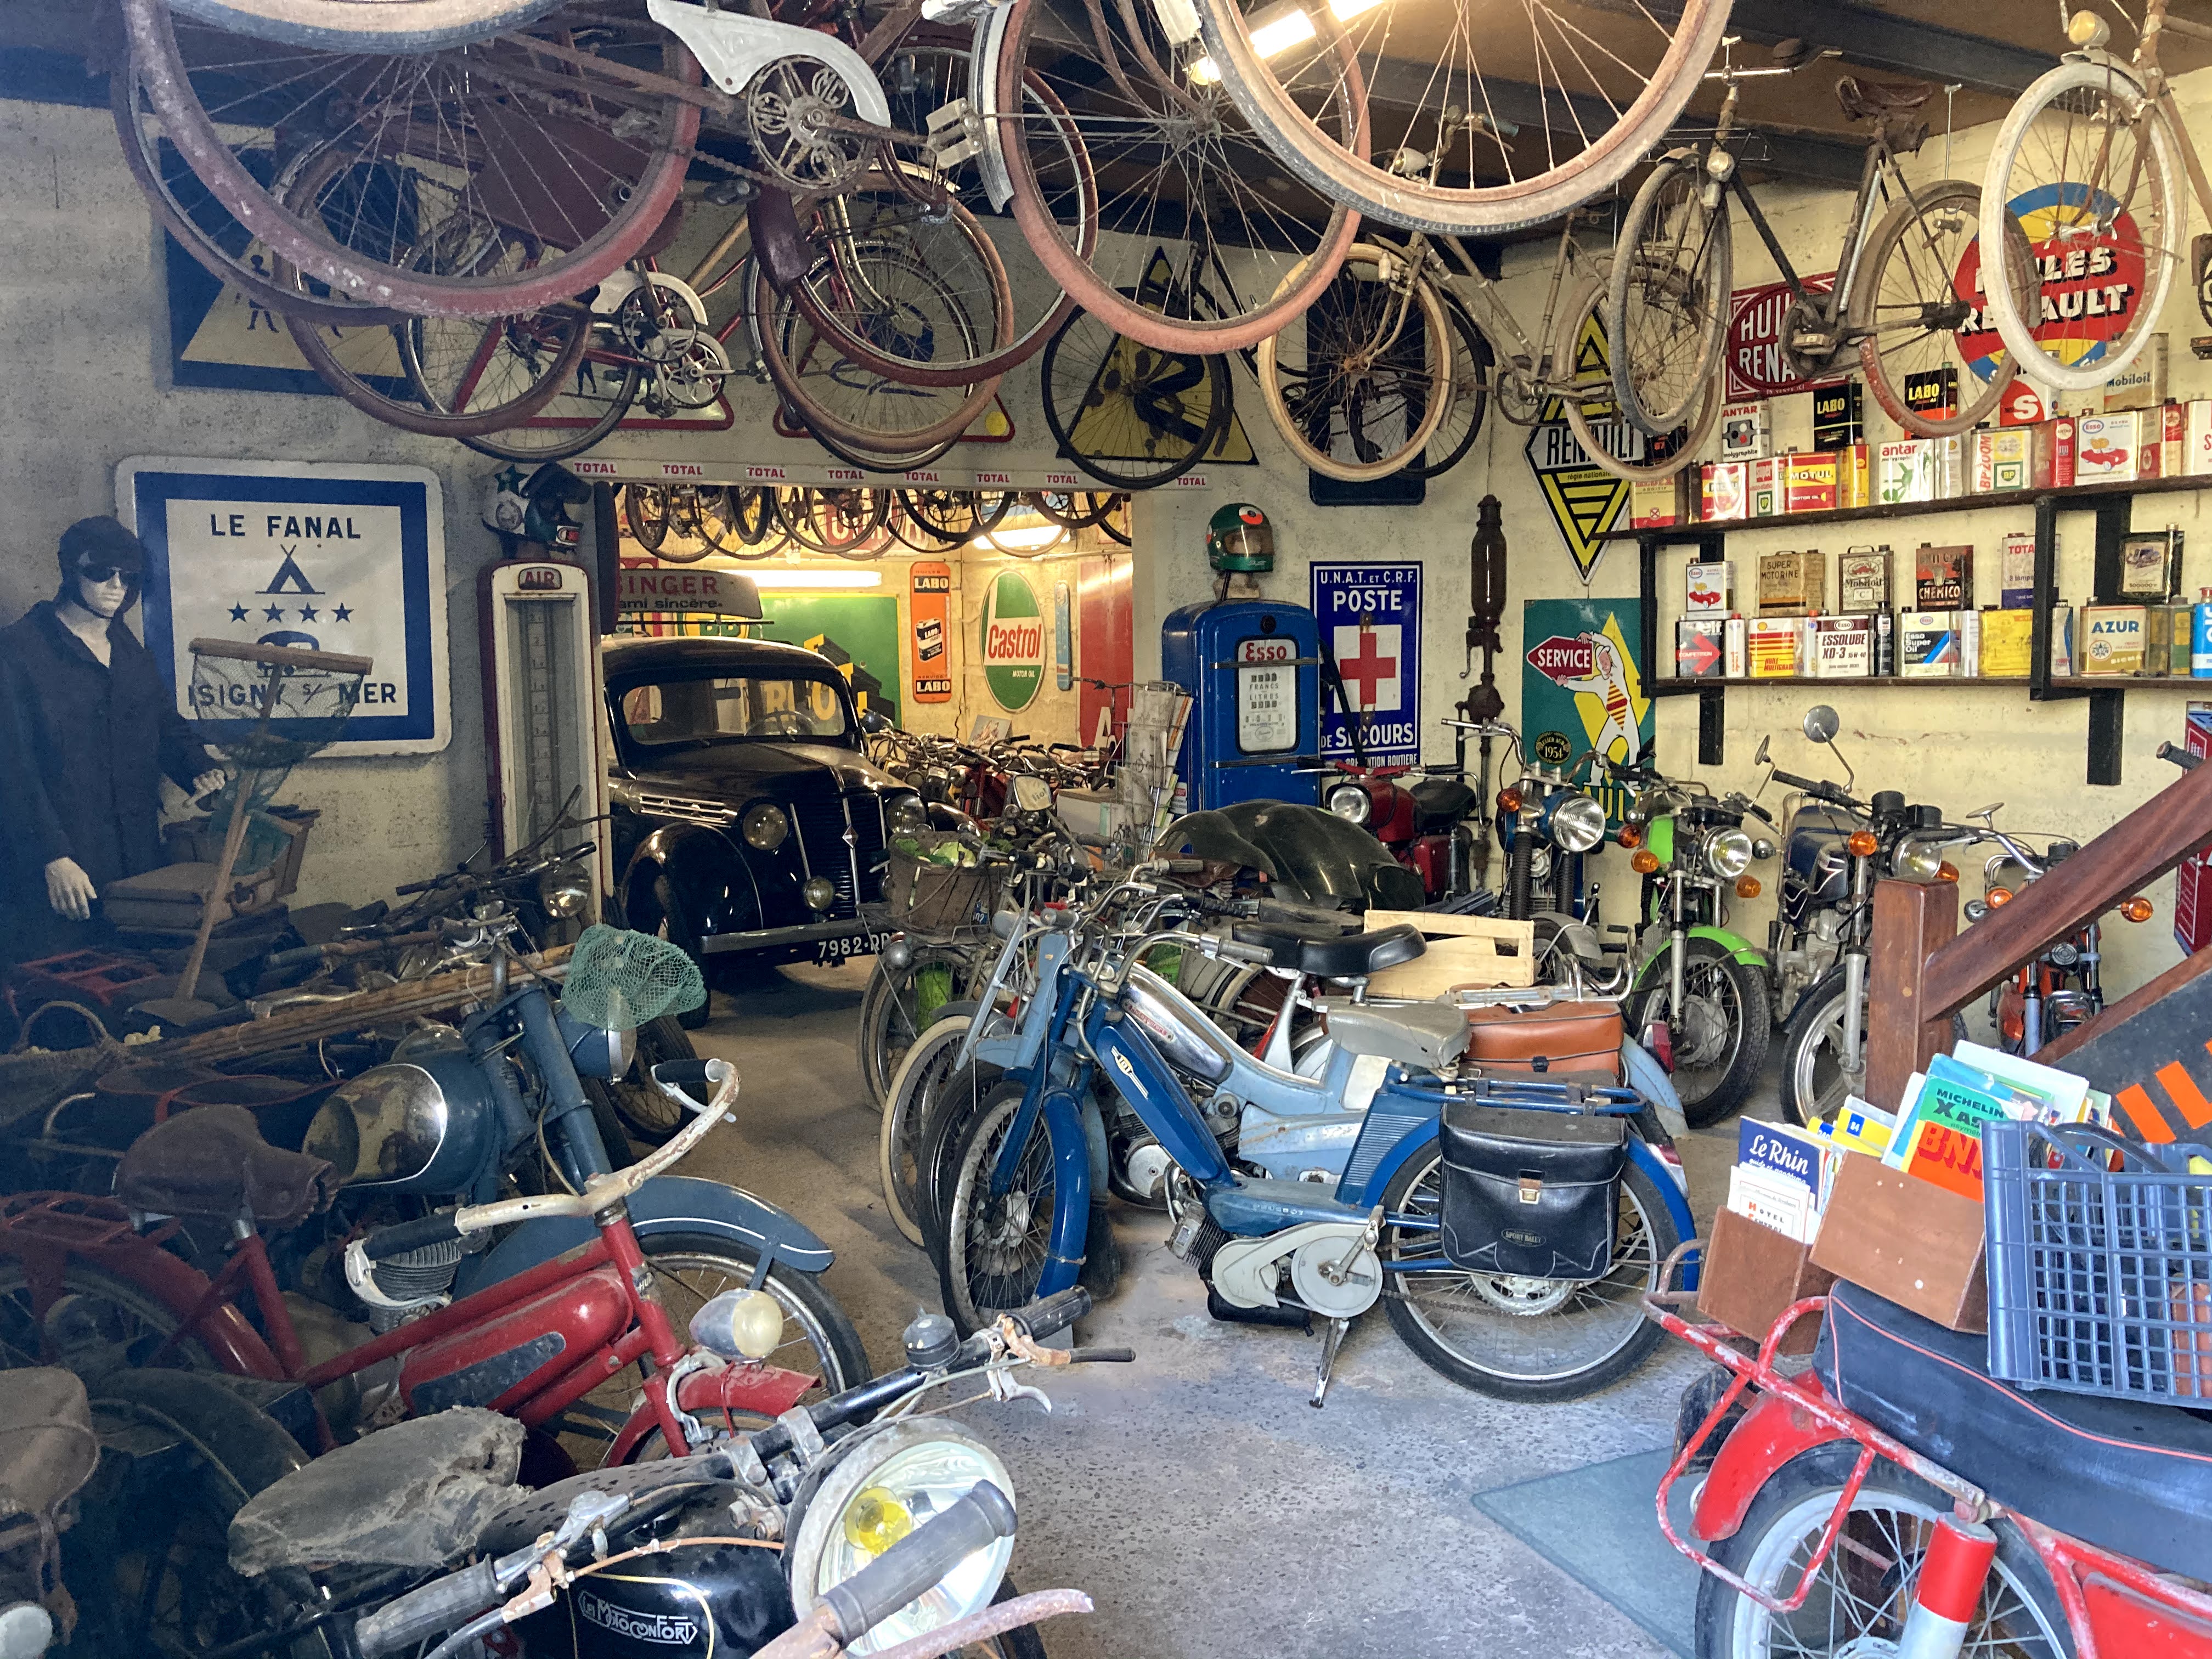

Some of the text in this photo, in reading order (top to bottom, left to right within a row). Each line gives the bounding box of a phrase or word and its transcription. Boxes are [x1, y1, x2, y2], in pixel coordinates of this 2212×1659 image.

[1957, 284, 2128, 333] REAULT
[1740, 342, 1795, 382] RENA
[1908, 383, 1939, 401] LABO
[1723, 405, 1758, 417] ANTAR
[1817, 398, 1845, 414] LABO
[1882, 444, 1917, 456] antar
[574, 462, 616, 473] TOTAL
[663, 465, 703, 476] TOTAL
[747, 467, 785, 478] TOTAL
[828, 470, 864, 480] TOTAL
[905, 471, 939, 482] TOTAL
[977, 473, 1009, 483] TOTAL
[1047, 475, 1078, 484] TOTAL
[1567, 471, 1582, 481] régie
[1790, 470, 1831, 479] MOTUL
[2004, 471, 2014, 479] BP
[1177, 477, 1206, 486] TOTAL
[211, 514, 360, 539] LE FANAL
[2008, 544, 2035, 554] TOTA
[1767, 561, 1791, 569] SUPER
[524, 571, 555, 586] AIR
[1369, 574, 1379, 583] ET
[1761, 569, 1799, 580] MOTORINE
[914, 578, 949, 590] LABO
[1919, 585, 1961, 599] CHEMICO
[1333, 590, 1402, 612] POSTE
[2091, 620, 2140, 633] AZUR
[924, 627, 938, 639] LABO
[988, 623, 1042, 659] Castrol
[1822, 634, 1866, 646] ESSOLUBE
[1537, 648, 1590, 670] SERVICE
[1822, 647, 1846, 659] XD-3
[916, 680, 950, 693] LABO
[188, 682, 284, 706] ISIGNY
[339, 682, 397, 704] MER
[1321, 735, 1332, 748] DE
[1545, 746, 1562, 758] 1954
[1937, 1088, 2004, 1118] MICHELIN
[1749, 1135, 1808, 1175] Le Rhin
[1505, 1231, 1524, 1241] SPORT
